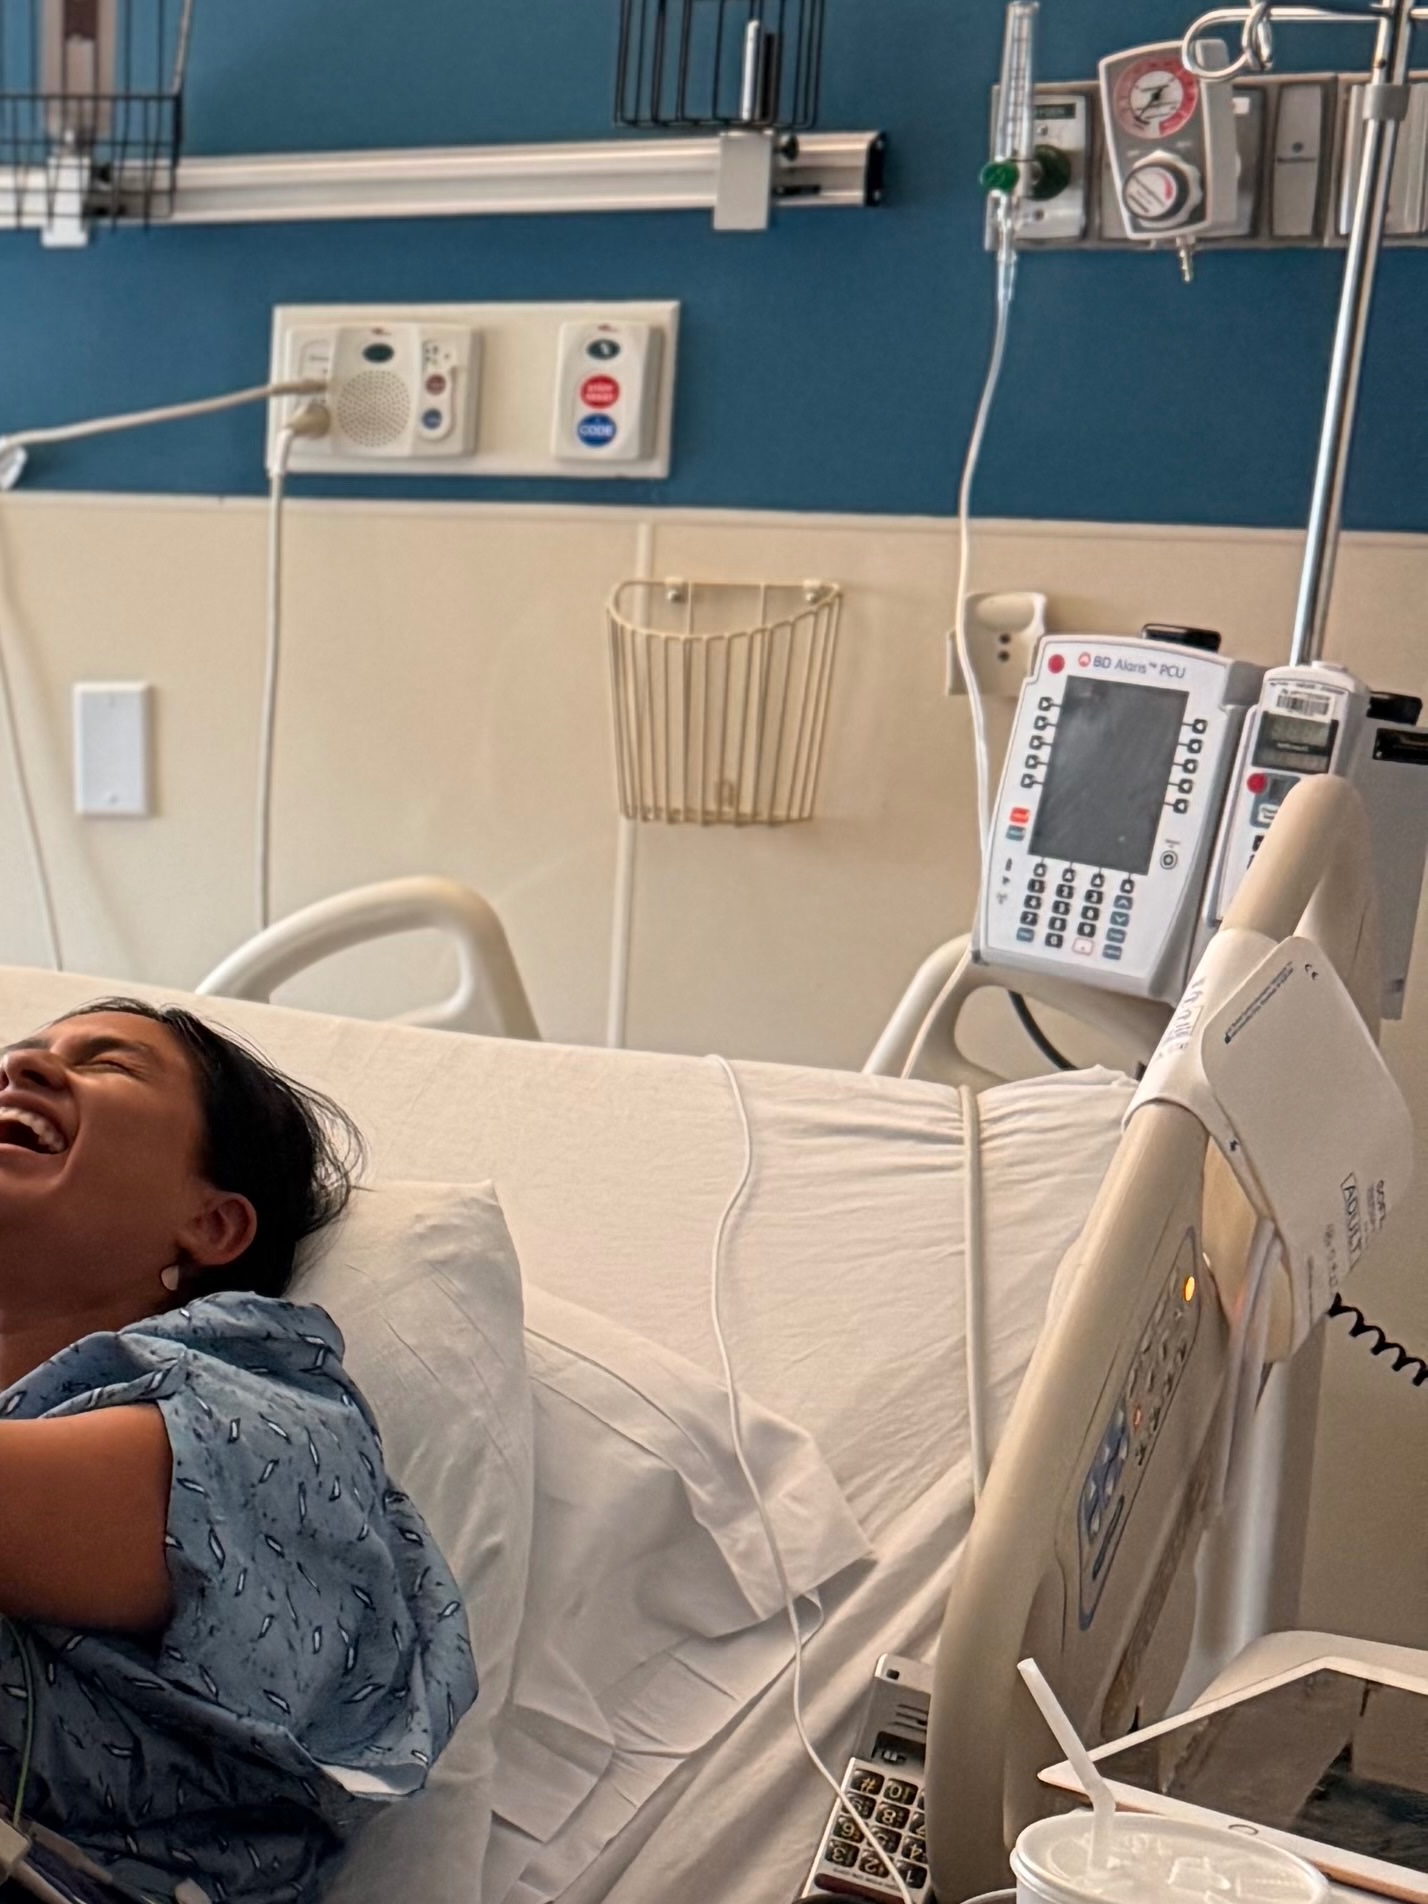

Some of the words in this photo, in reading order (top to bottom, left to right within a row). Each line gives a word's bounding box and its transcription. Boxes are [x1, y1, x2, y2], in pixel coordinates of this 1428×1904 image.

[1093, 655, 1112, 670] BD
[1159, 663, 1187, 679] PCU
[1344, 1185, 1362, 1253] ADULT
[882, 1809, 897, 1824] 8
[841, 1822, 856, 1837] 6
[831, 1847, 847, 1862] 3
[864, 1857, 880, 1873] 2
